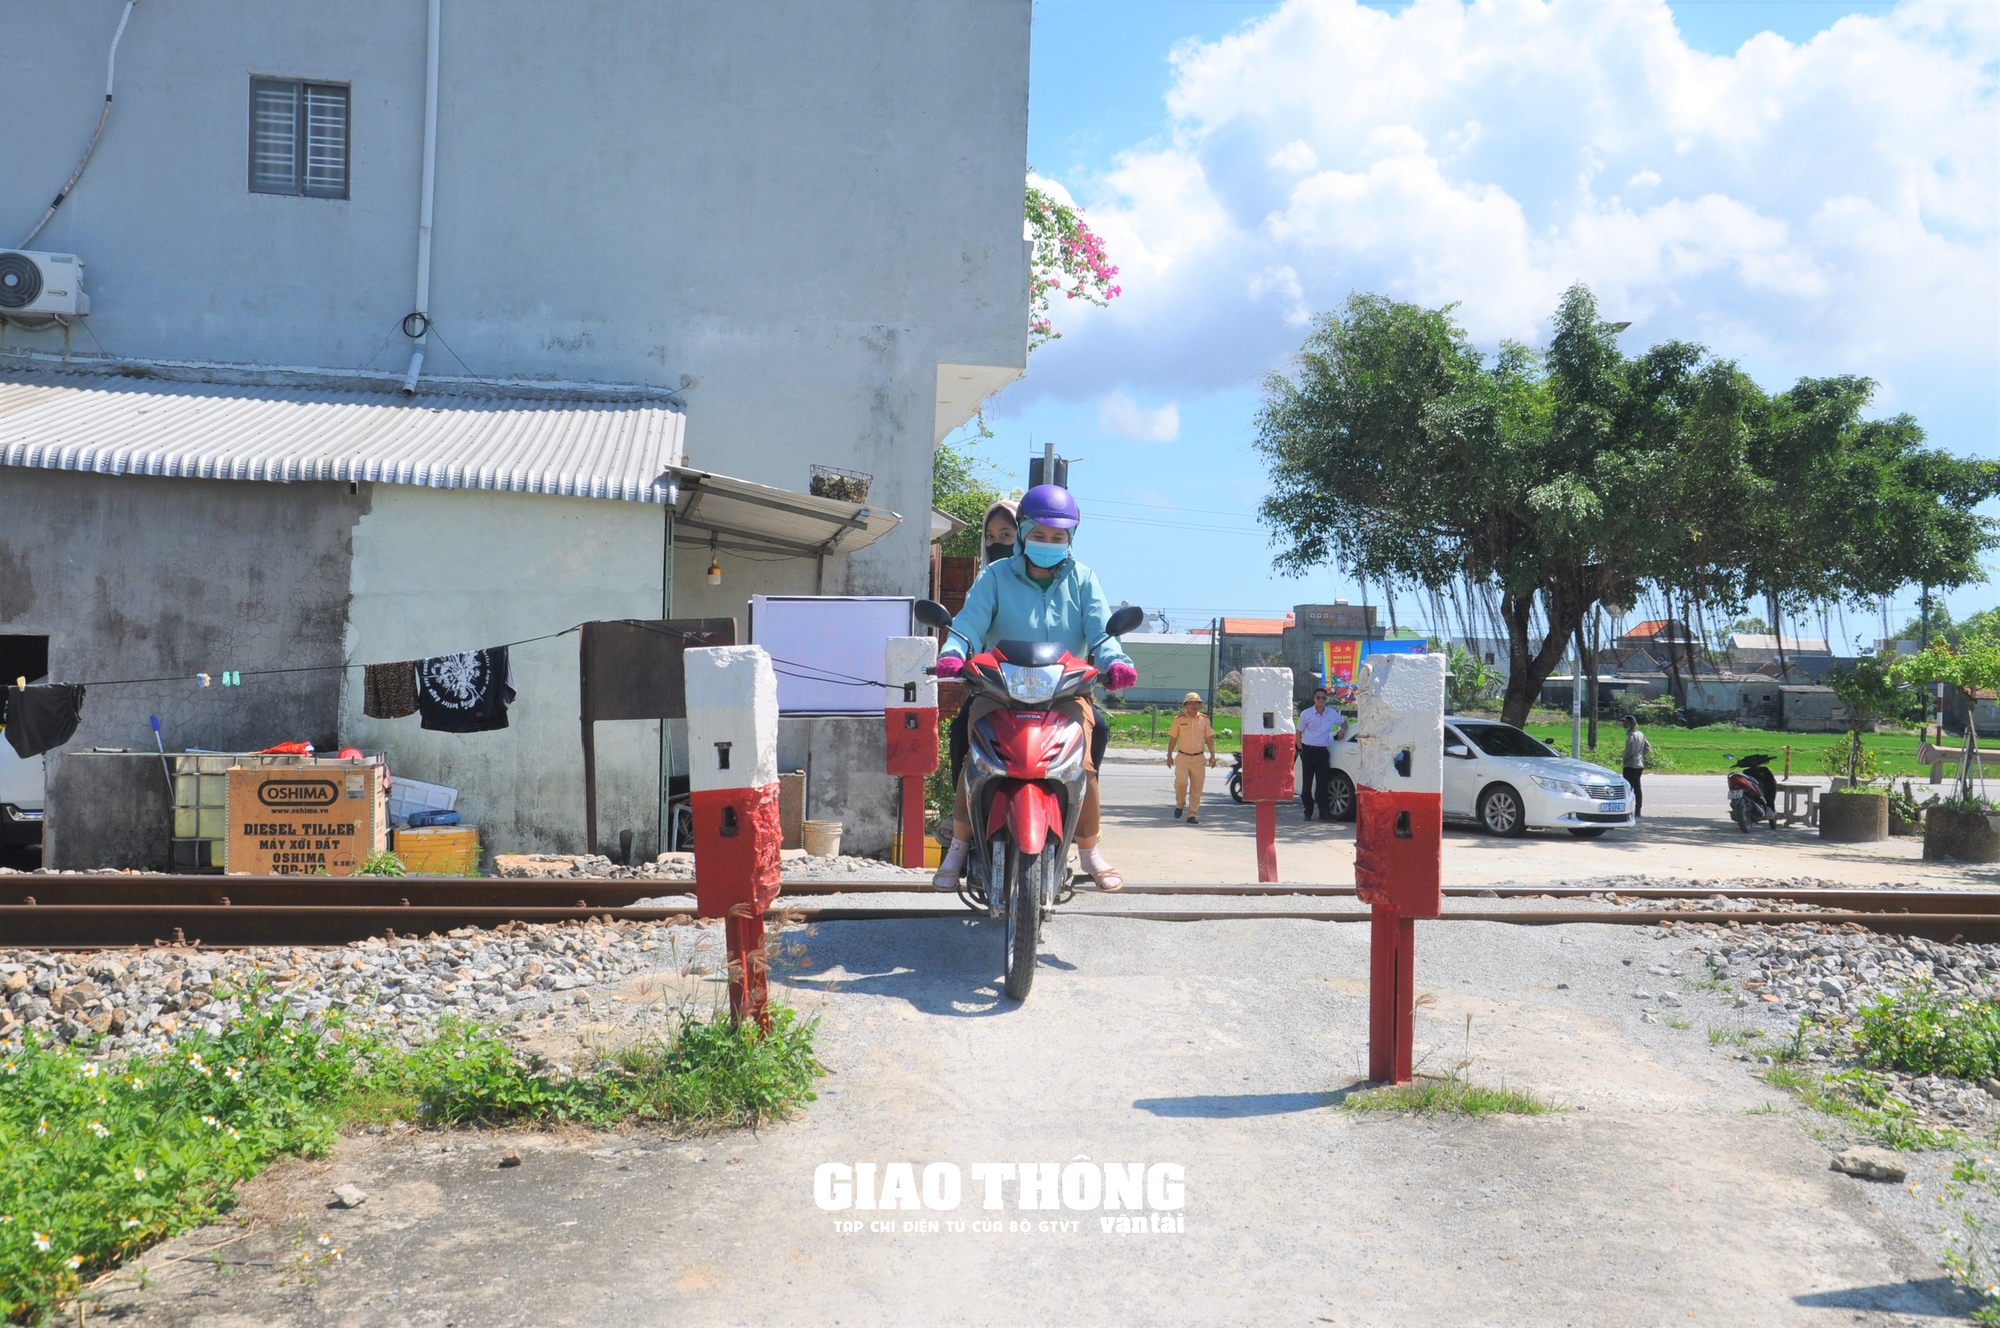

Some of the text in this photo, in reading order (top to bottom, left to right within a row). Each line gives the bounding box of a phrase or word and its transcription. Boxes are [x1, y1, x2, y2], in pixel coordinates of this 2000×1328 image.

[428, 688, 441, 702] days
[441, 700, 459, 710] better
[267, 787, 328, 799] OSHIMA
[244, 823, 355, 836] DIESEL TILLER
[259, 837, 286, 850] MÁY
[315, 836, 340, 850] ĐẤT
[272, 852, 326, 863] OSHIMA
